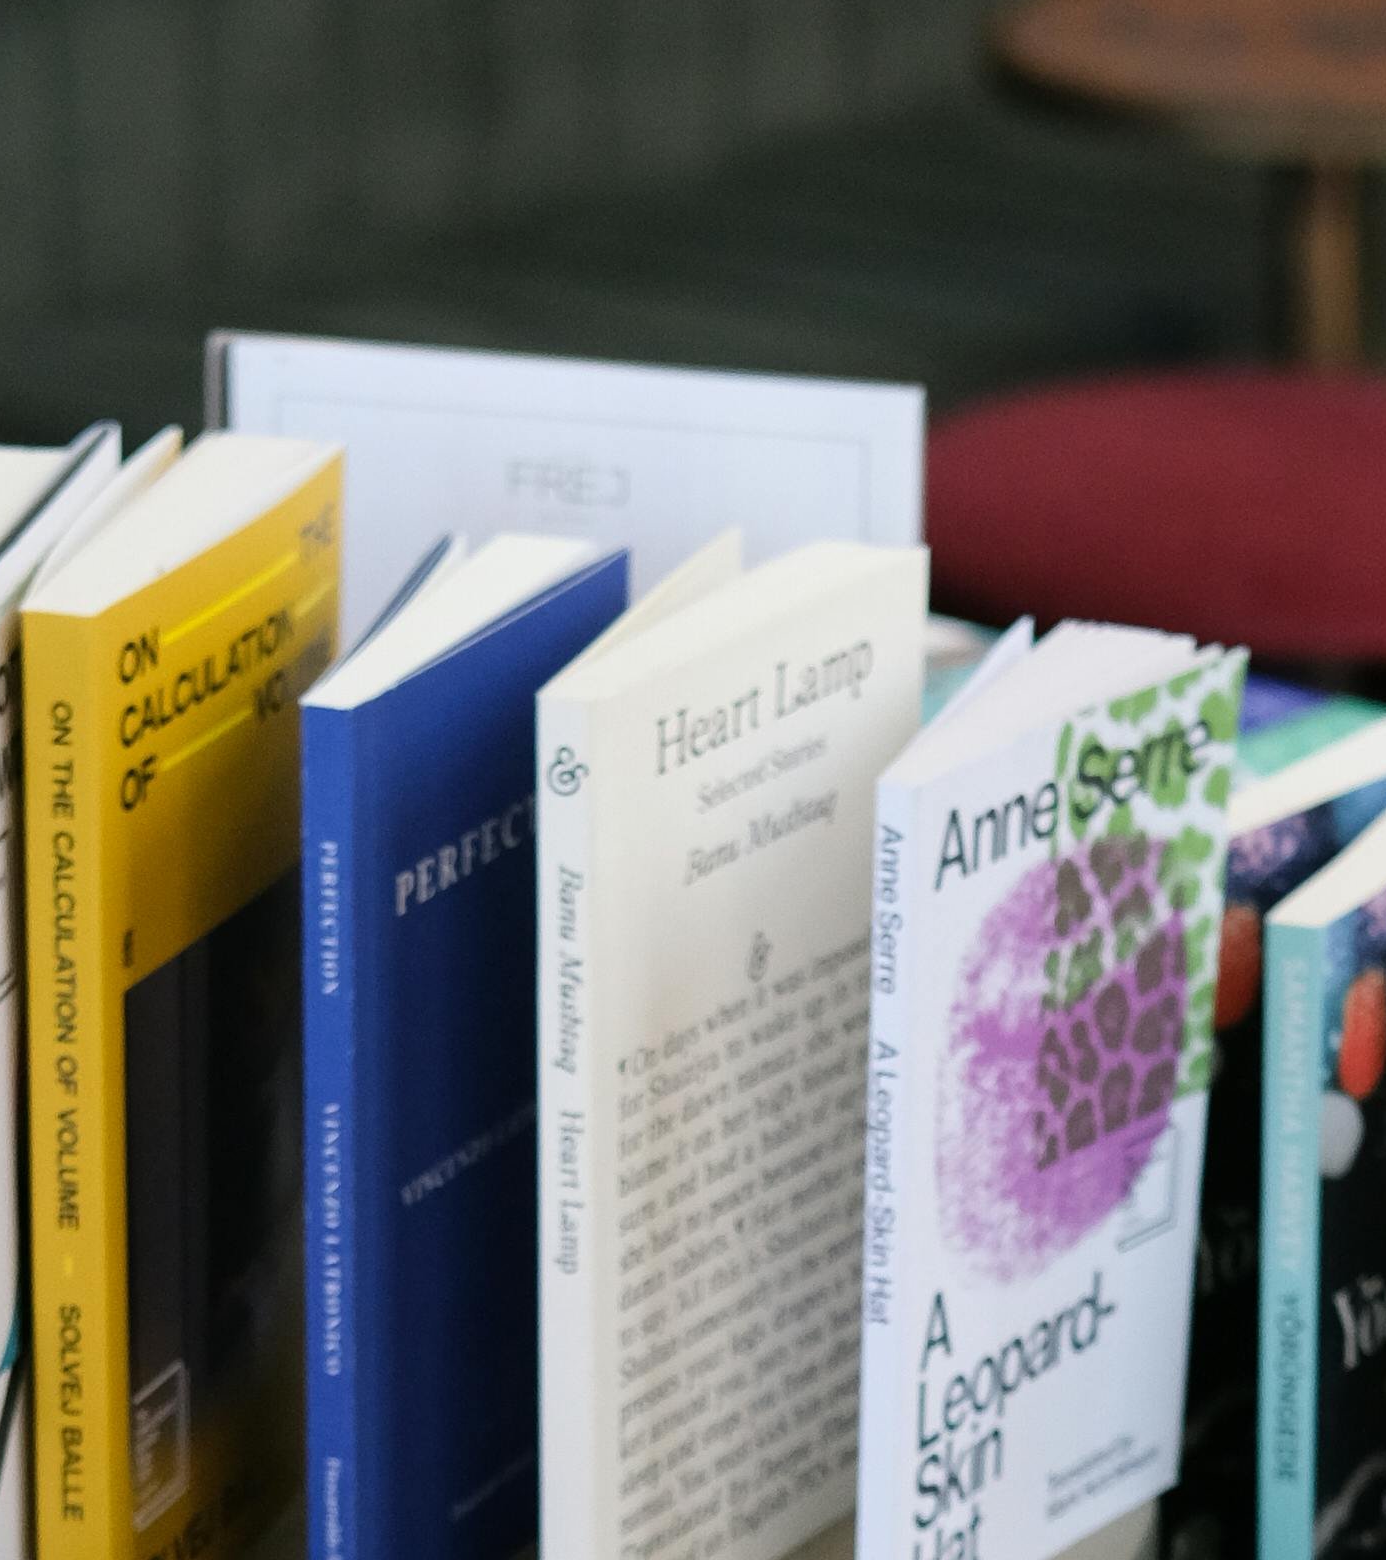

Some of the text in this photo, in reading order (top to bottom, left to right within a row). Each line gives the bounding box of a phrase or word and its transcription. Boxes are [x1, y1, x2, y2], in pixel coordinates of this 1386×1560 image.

[118, 626, 160, 685] ON
[118, 606, 297, 749] CALCULATION
[655, 640, 873, 777] Heart Lamp
[119, 752, 158, 811] OF
[934, 719, 1209, 892] Anne Serre
[50, 700, 81, 1230] ON THE CALCULATION OF VOLUME
[875, 824, 904, 996] Anne Serre
[873, 1040, 898, 1062] A
[918, 1270, 1116, 1451] Leopard-
[920, 1291, 952, 1372] A
[58, 1304, 84, 1522] SOLVEJ BALLE
[913, 1421, 1002, 1530] Skin
